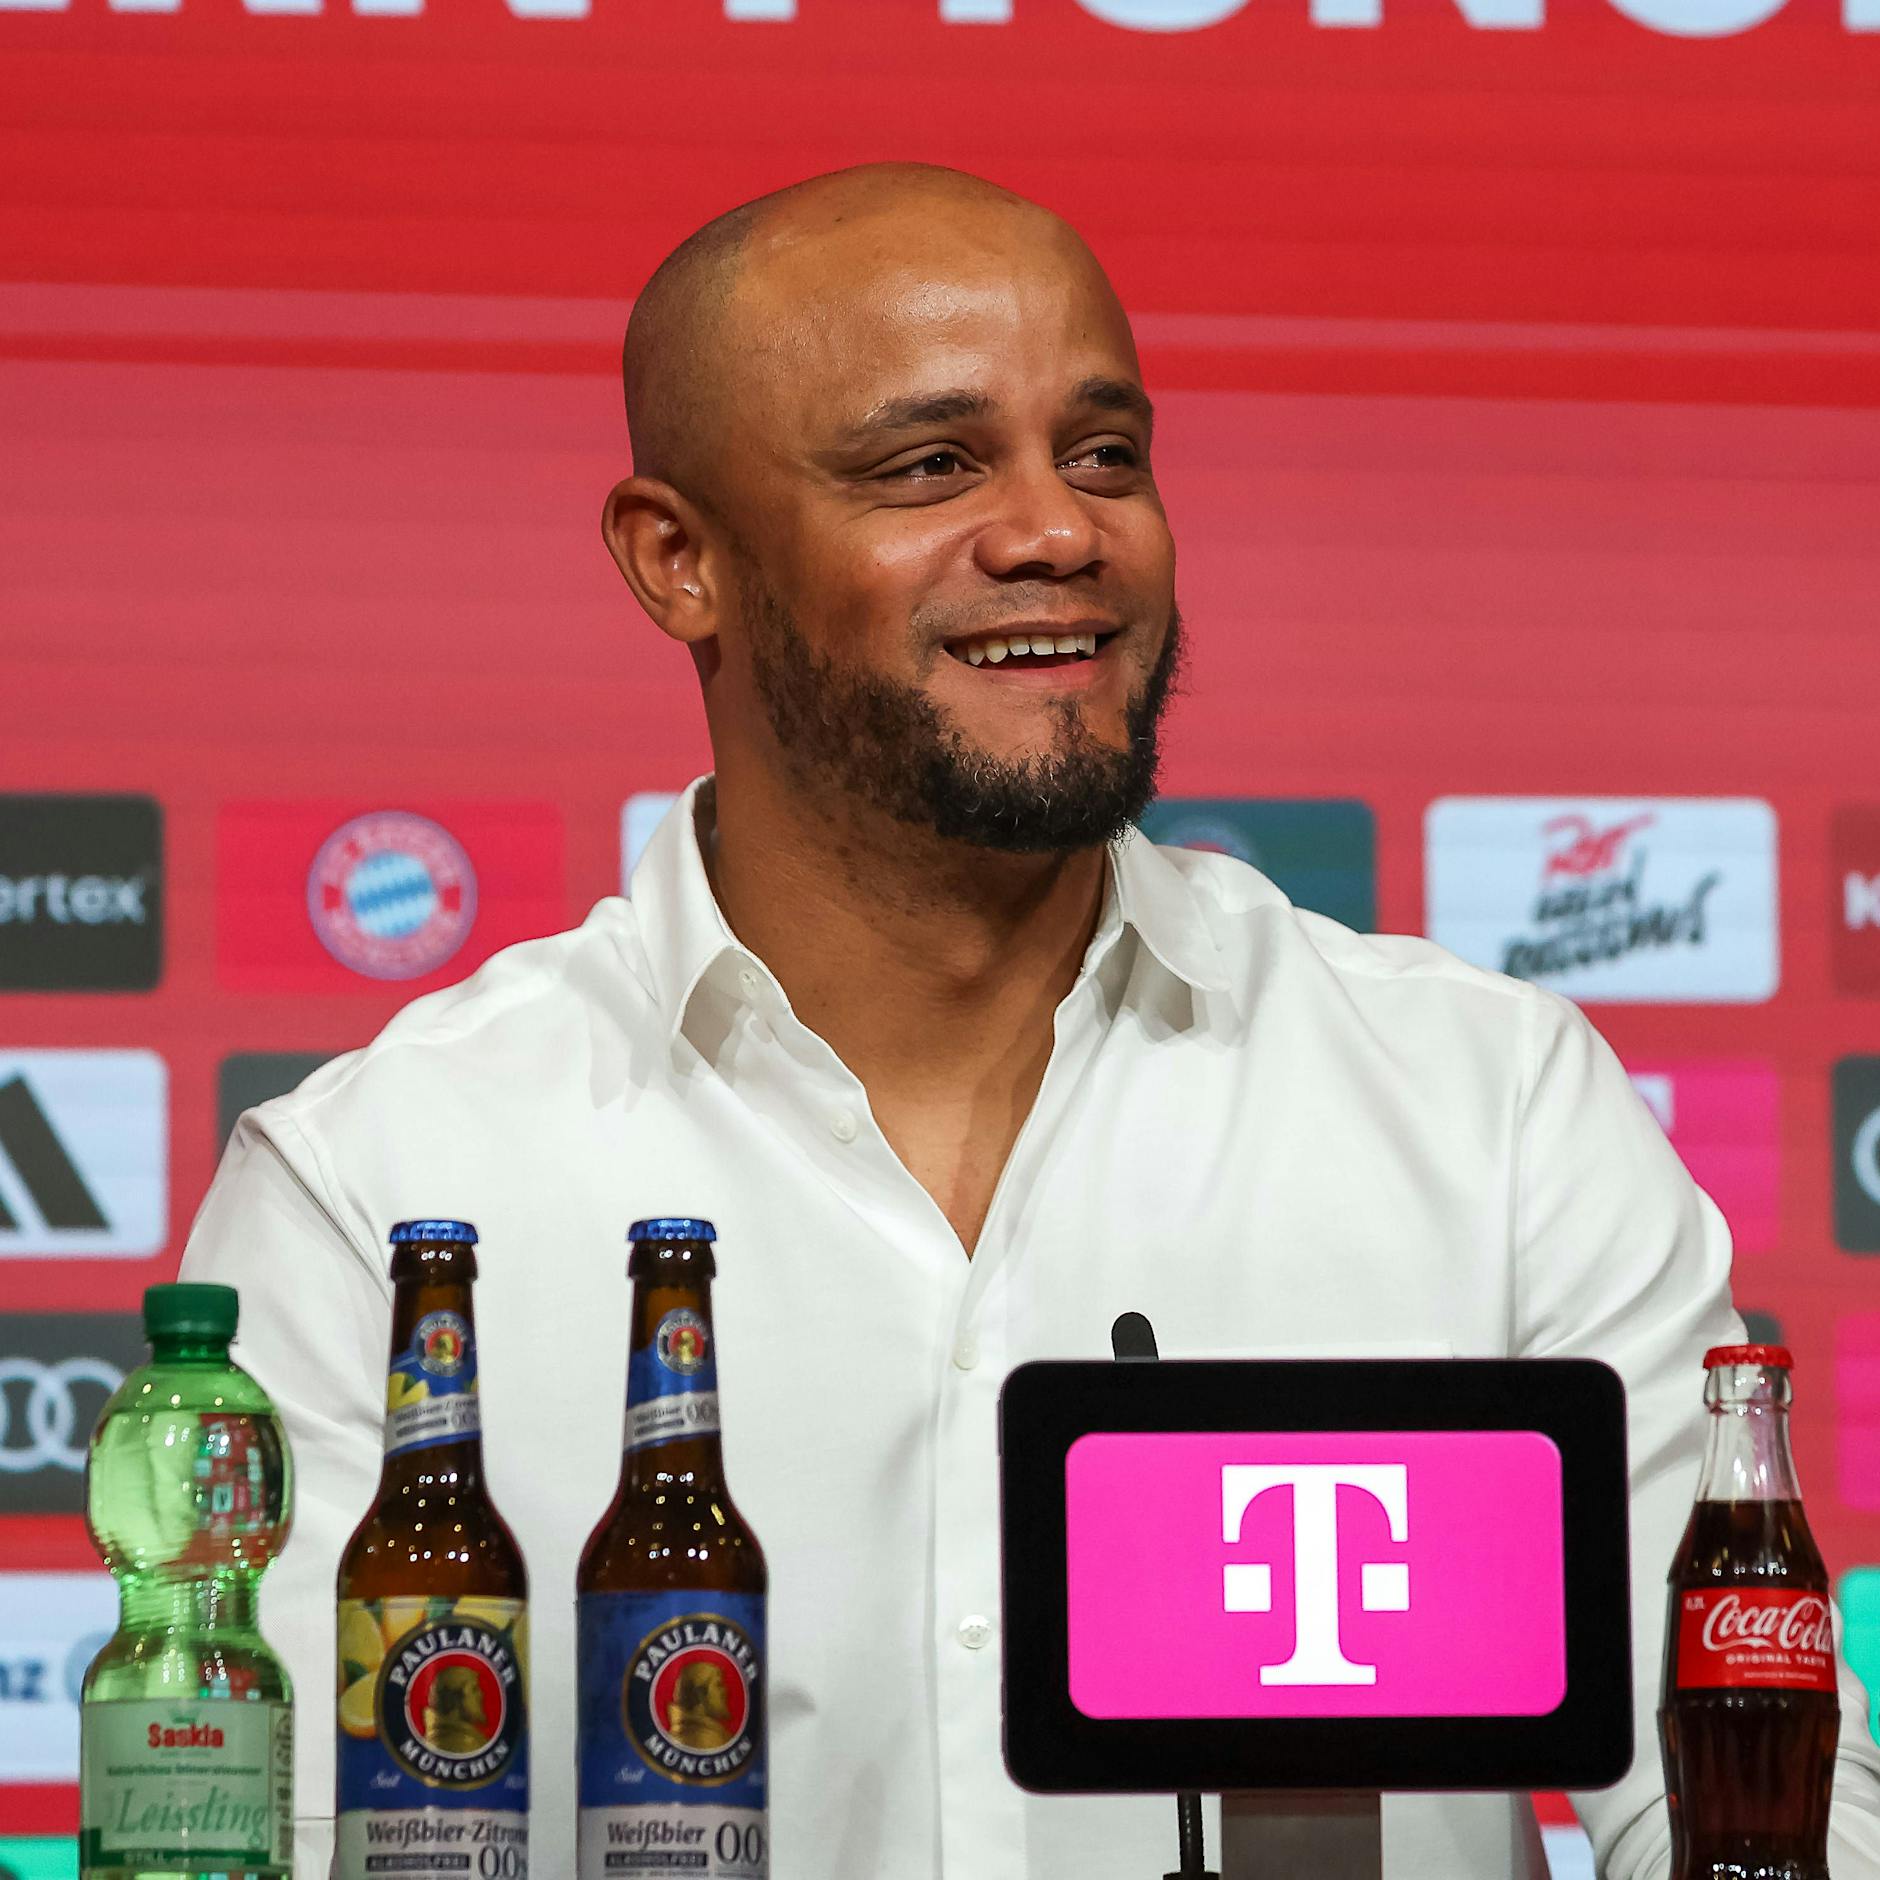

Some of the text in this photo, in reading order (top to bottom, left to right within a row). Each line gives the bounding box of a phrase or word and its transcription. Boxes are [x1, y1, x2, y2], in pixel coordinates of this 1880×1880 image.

[634, 1623, 758, 1683] PAULANER
[1702, 1594, 1832, 1654] Coca-Cola
[389, 1627, 516, 1687] PAULANER
[147, 1722, 225, 1749] Saskia
[607, 1820, 706, 1850] Weißbier
